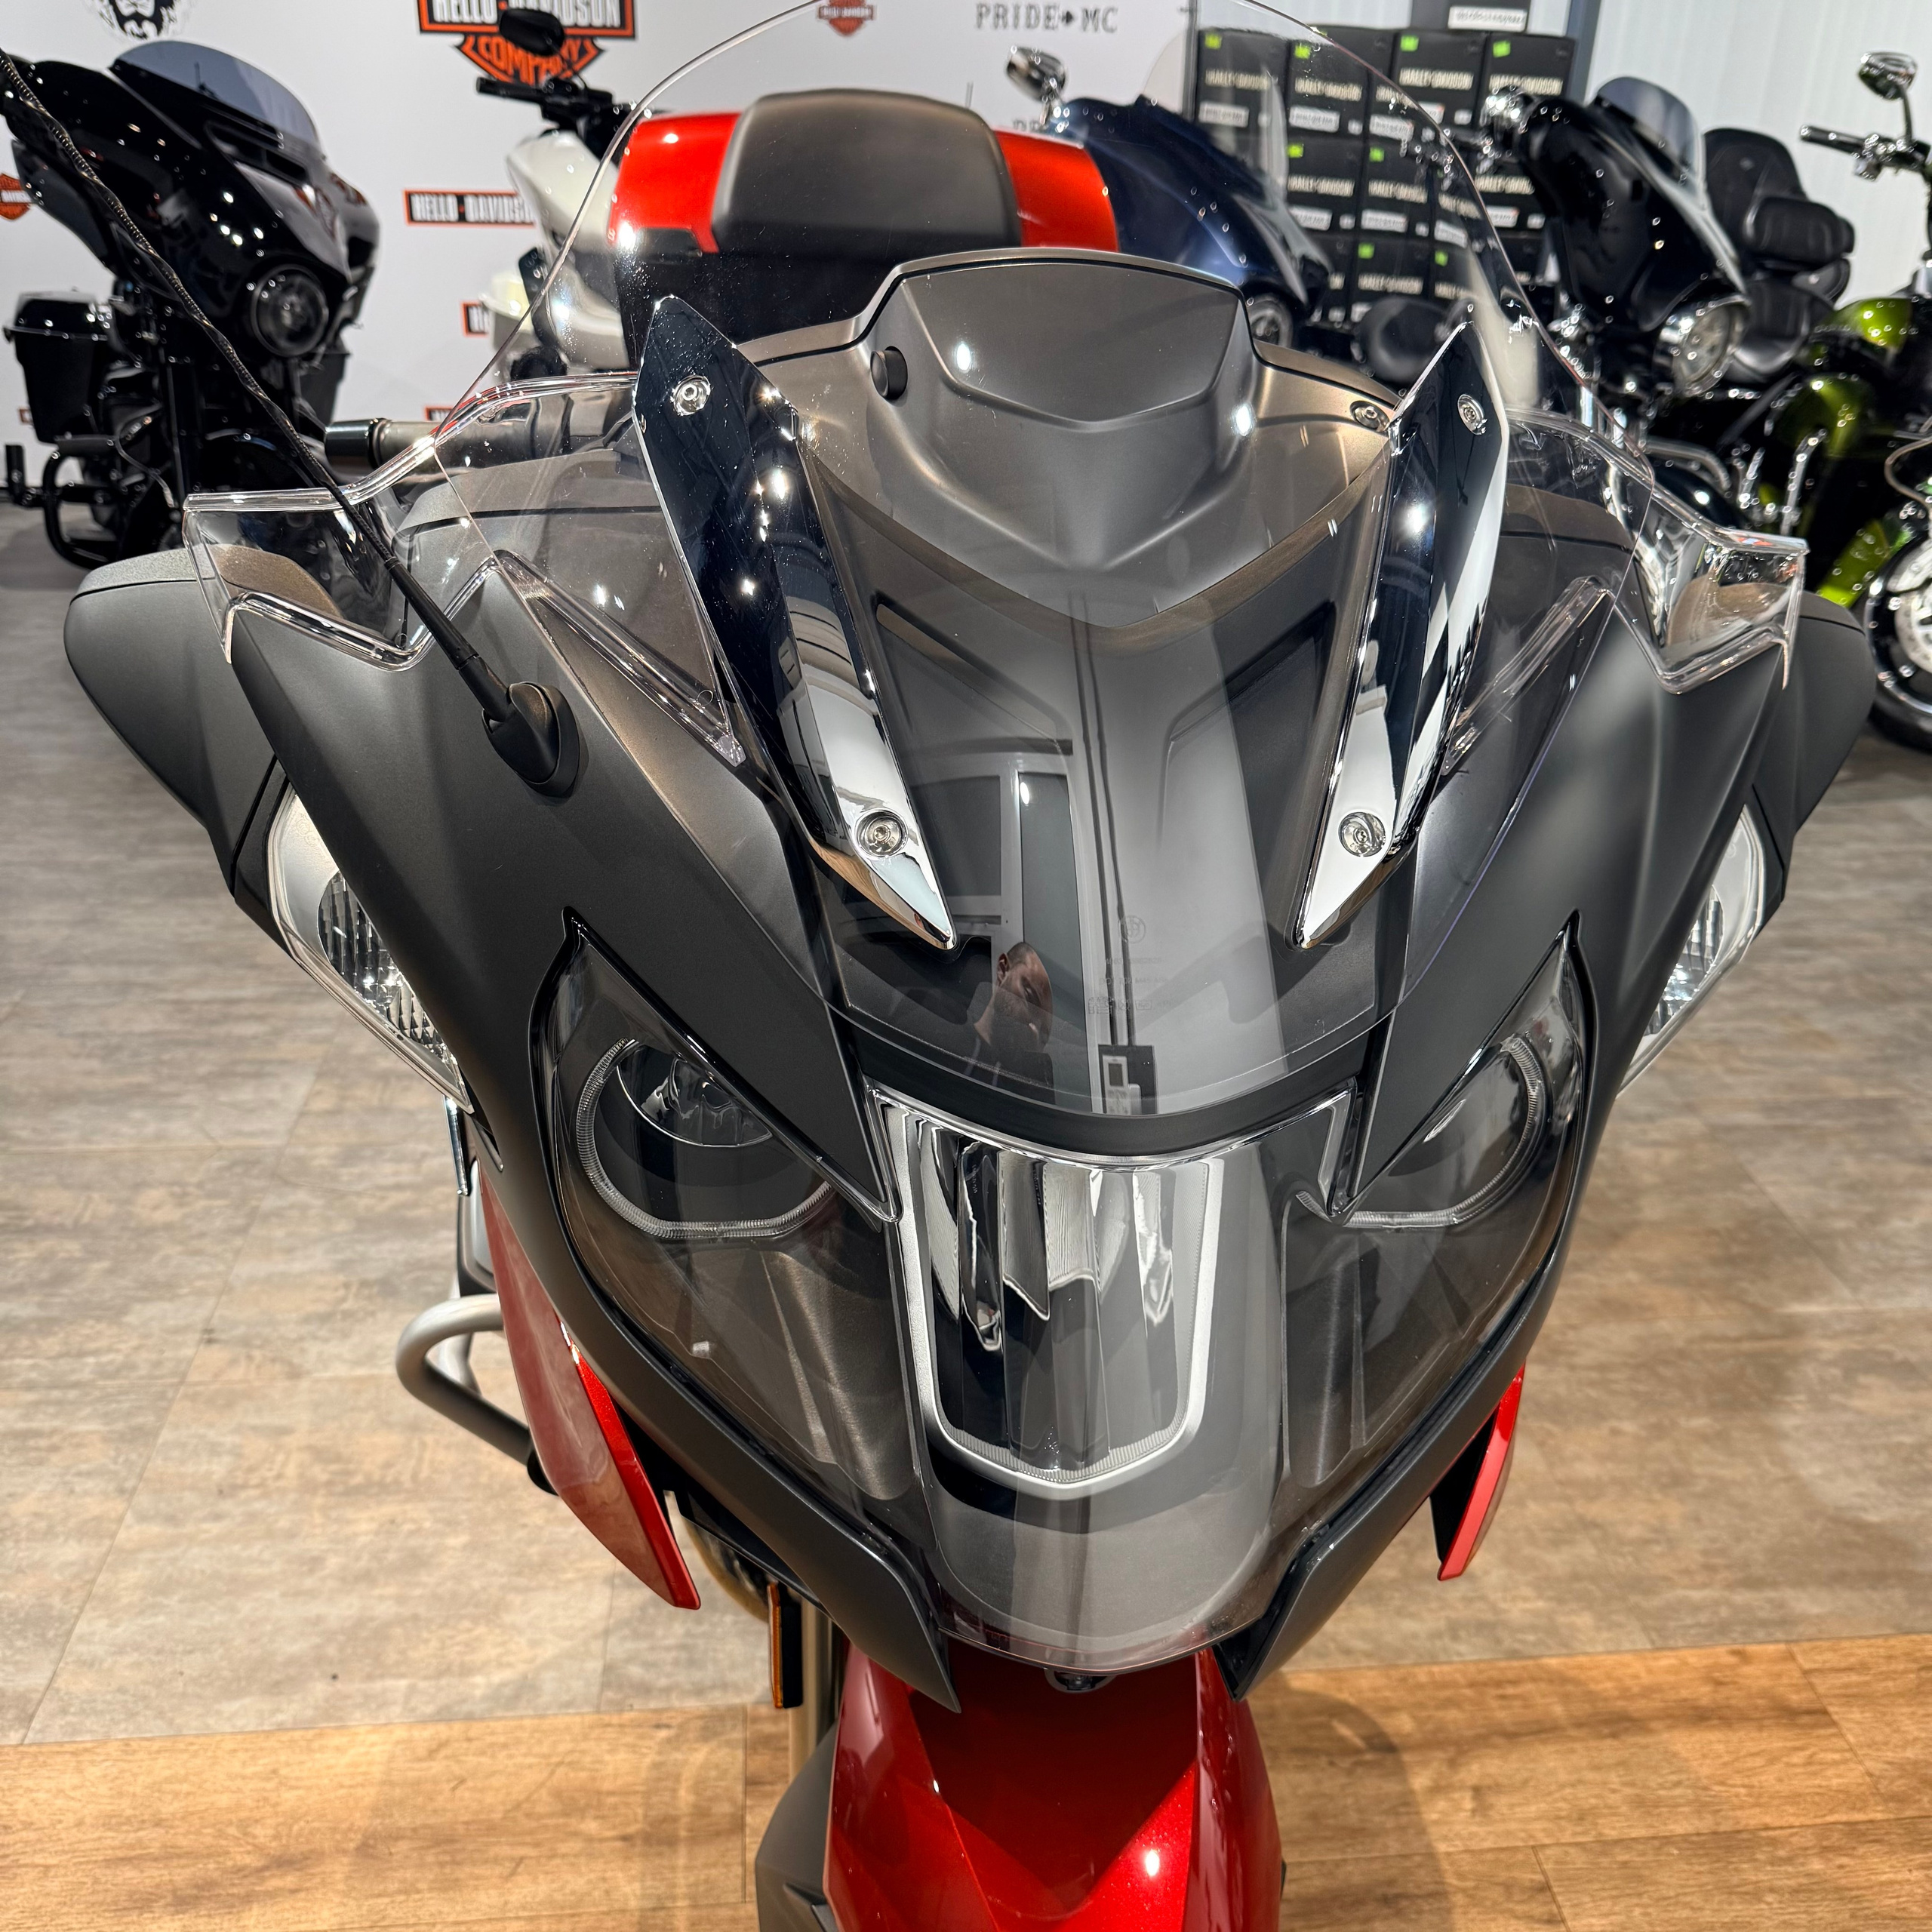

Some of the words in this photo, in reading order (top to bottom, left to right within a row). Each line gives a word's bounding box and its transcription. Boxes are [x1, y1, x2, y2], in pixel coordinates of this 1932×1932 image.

[976, 3, 1058, 30] PRIDE
[1081, 7, 1118, 32] MC
[411, 192, 459, 222] HELLO
